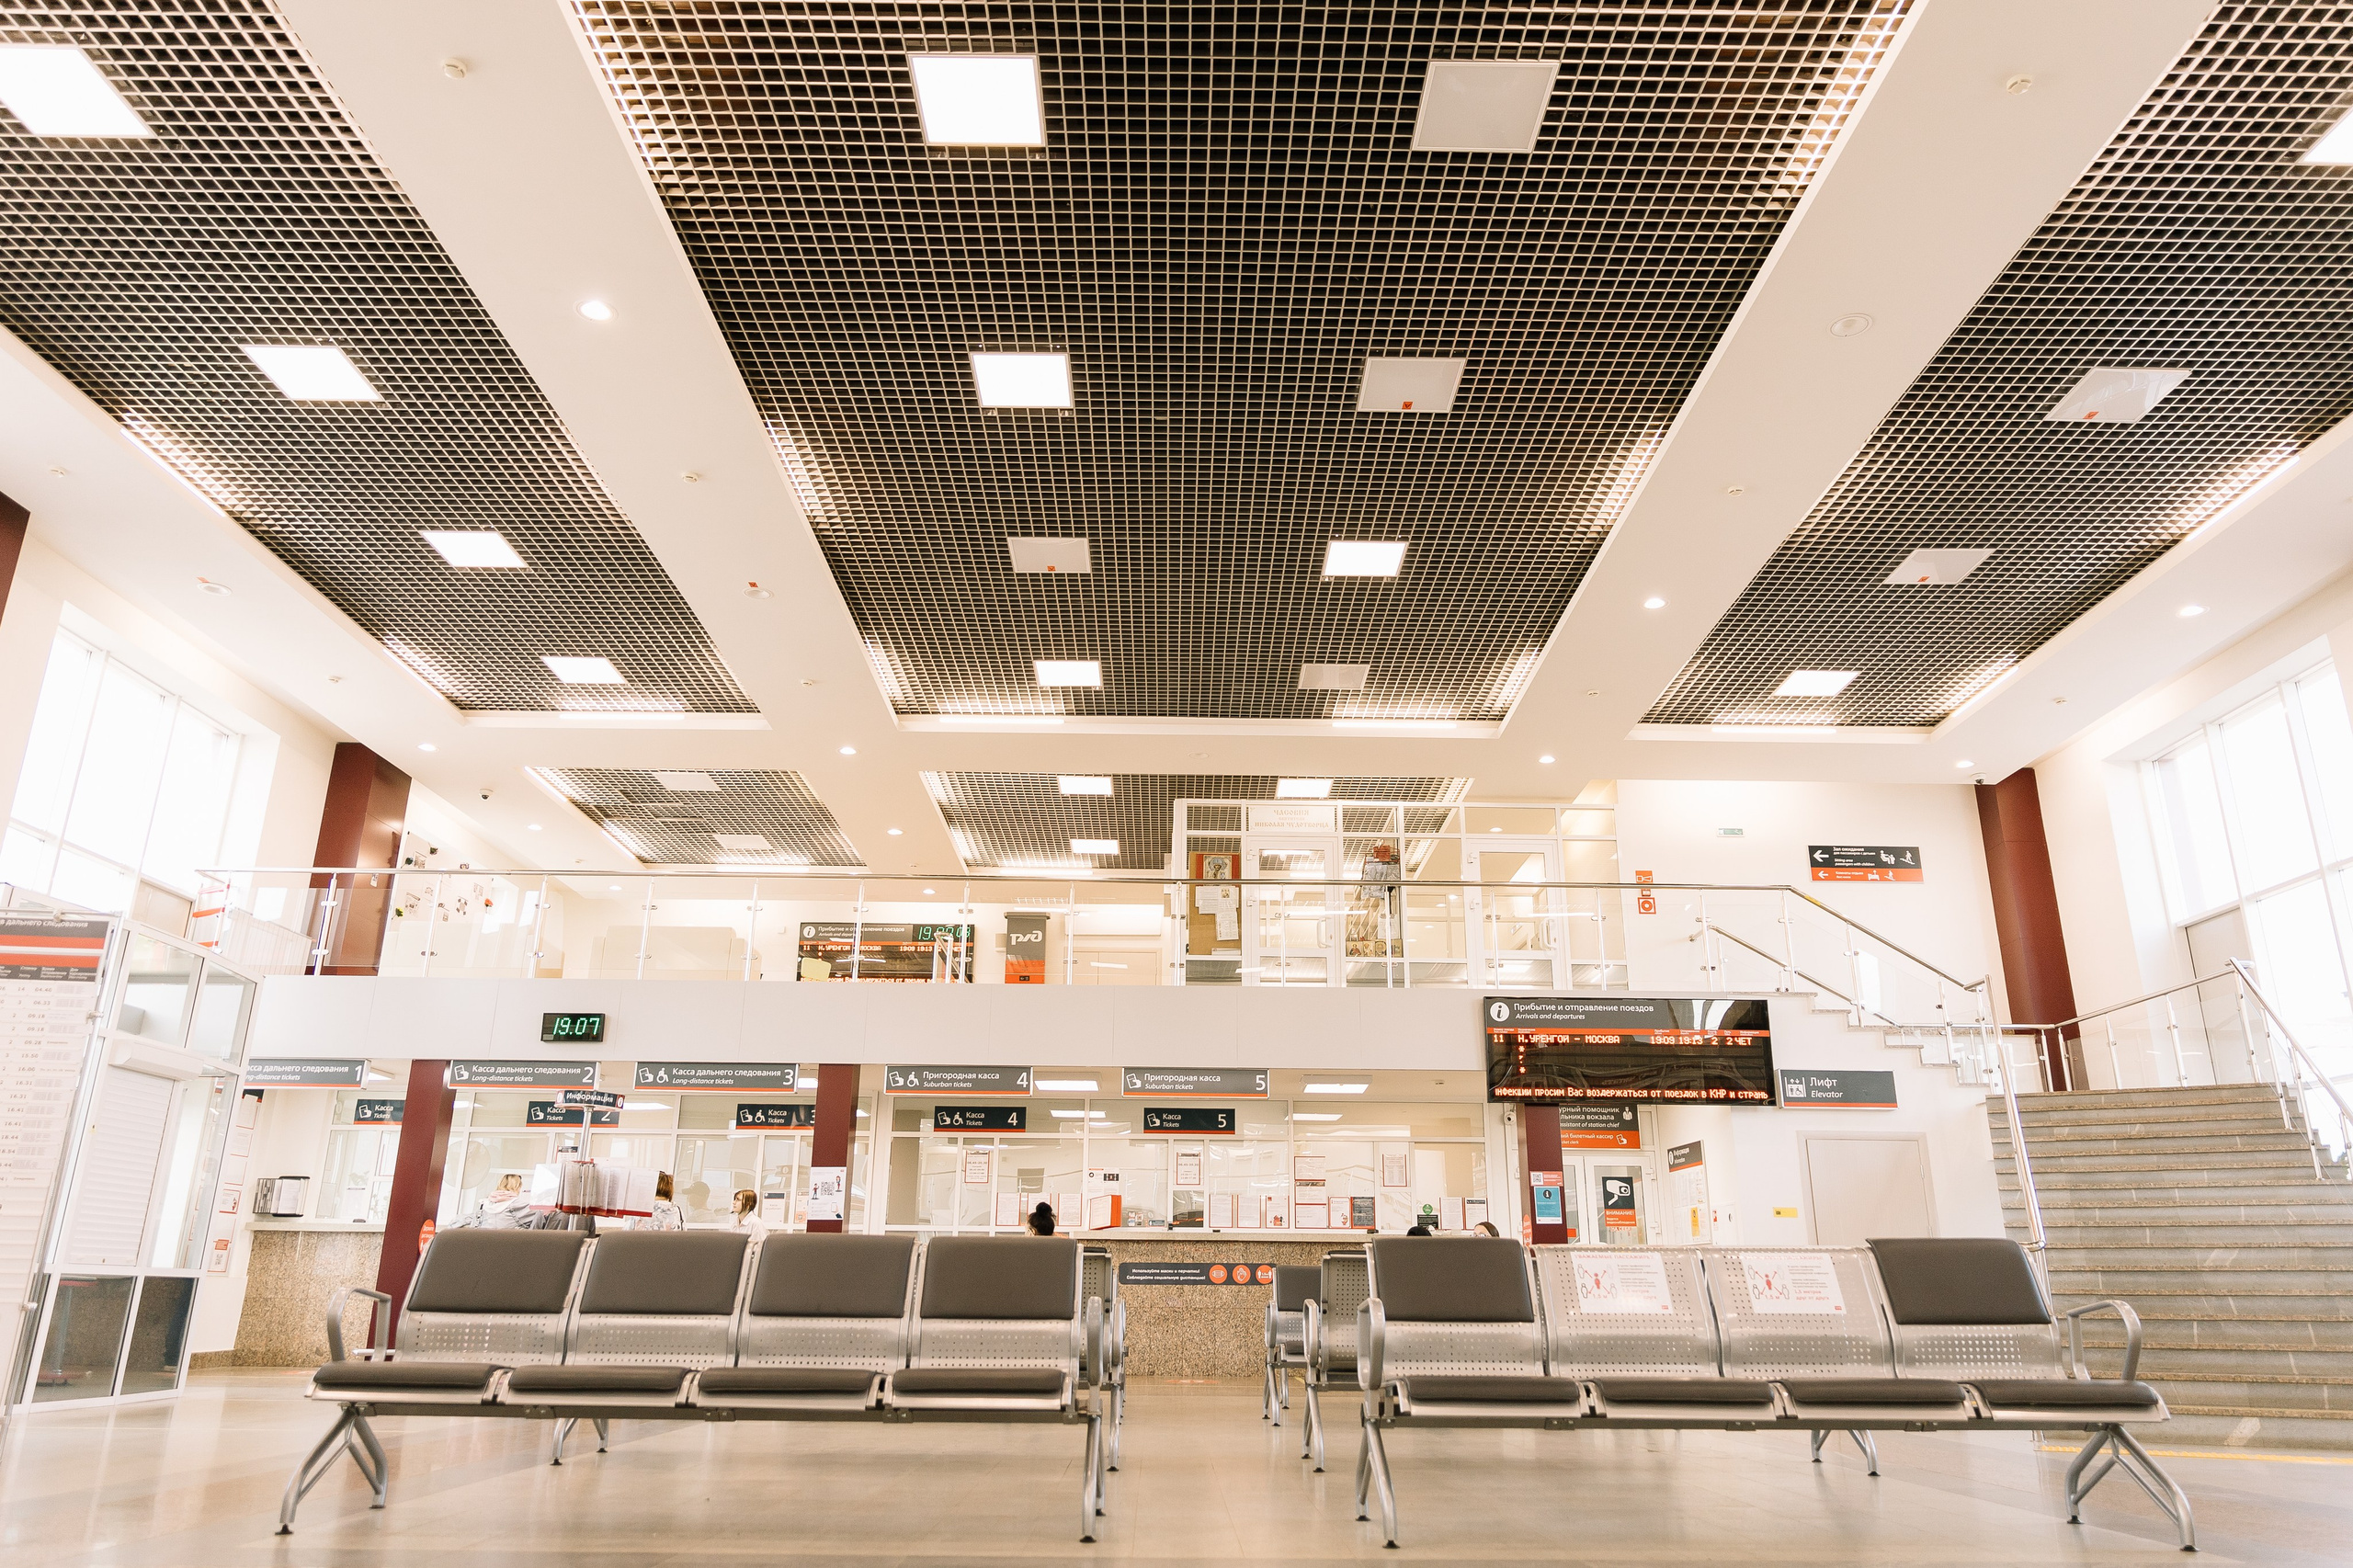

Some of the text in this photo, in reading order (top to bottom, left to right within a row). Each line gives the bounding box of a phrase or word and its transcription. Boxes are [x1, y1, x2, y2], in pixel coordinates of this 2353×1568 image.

[1514, 1004, 1556, 1012] Прибытие
[552, 1017, 600, 1035] 19.07
[1494, 1034, 1752, 1046] 11 Н.УРЕНГОЙ МОСКВА 19:09 19:13 2 2 ЧЕТ
[355, 1065, 362, 1082] 1
[495, 1066, 533, 1074] дальнего
[534, 1067, 581, 1075] следования
[582, 1067, 594, 1083] 2
[673, 1067, 695, 1075] Касса
[697, 1069, 733, 1077] дальнего
[783, 1069, 793, 1085] 3
[923, 1071, 977, 1080] Пригородная
[1017, 1072, 1029, 1087] 4
[672, 1077, 715, 1085] Long-distance
[1144, 1074, 1198, 1083] Пригородная
[1256, 1075, 1266, 1091] 5
[1810, 1077, 1837, 1088] Лифт
[566, 1092, 613, 1103] Информация
[1534, 1088, 1564, 1096] просим
[1567, 1087, 1584, 1096] Вас
[1586, 1089, 1648, 1097] воздержаться
[1665, 1090, 1699, 1098] поездок
[1710, 1089, 1726, 1098] КНР
[1811, 1090, 1843, 1098] Elevator
[1007, 1112, 1017, 1126] 4
[1218, 1114, 1227, 1128] 5
